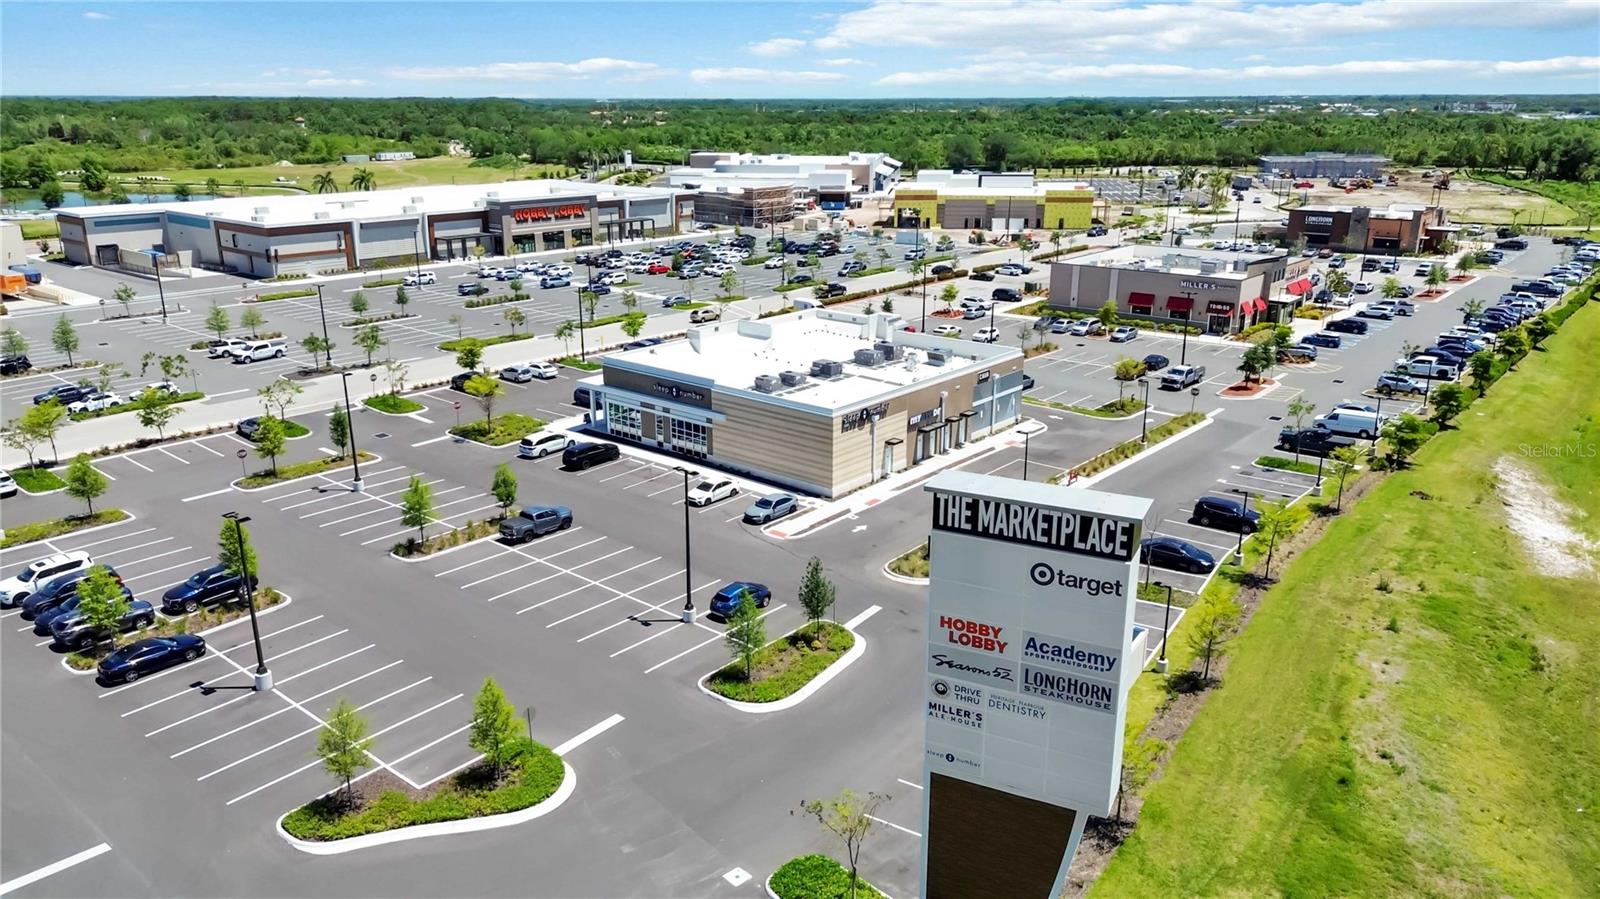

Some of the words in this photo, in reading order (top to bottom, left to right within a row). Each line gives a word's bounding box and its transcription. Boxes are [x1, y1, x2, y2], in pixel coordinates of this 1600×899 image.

[514, 208, 551, 220] HOBBY
[554, 204, 588, 217] LOBBY
[936, 493, 973, 531] THE
[977, 499, 1130, 557] MARKETPLACE
[1057, 569, 1122, 597] target
[939, 615, 1003, 639] HOBBY
[949, 630, 1008, 654] LOBBY
[1025, 637, 1117, 672] Academy
[931, 654, 991, 676] Seasons
[992, 667, 1014, 682] 52
[954, 684, 982, 698] DRIVE
[1024, 668, 1112, 703] LONGHORN
[954, 693, 980, 705] THRU
[988, 698, 1046, 720] DENTISTRY
[1024, 685, 1112, 711] STEAKHOUSE
[928, 702, 983, 721] MILLER'S
